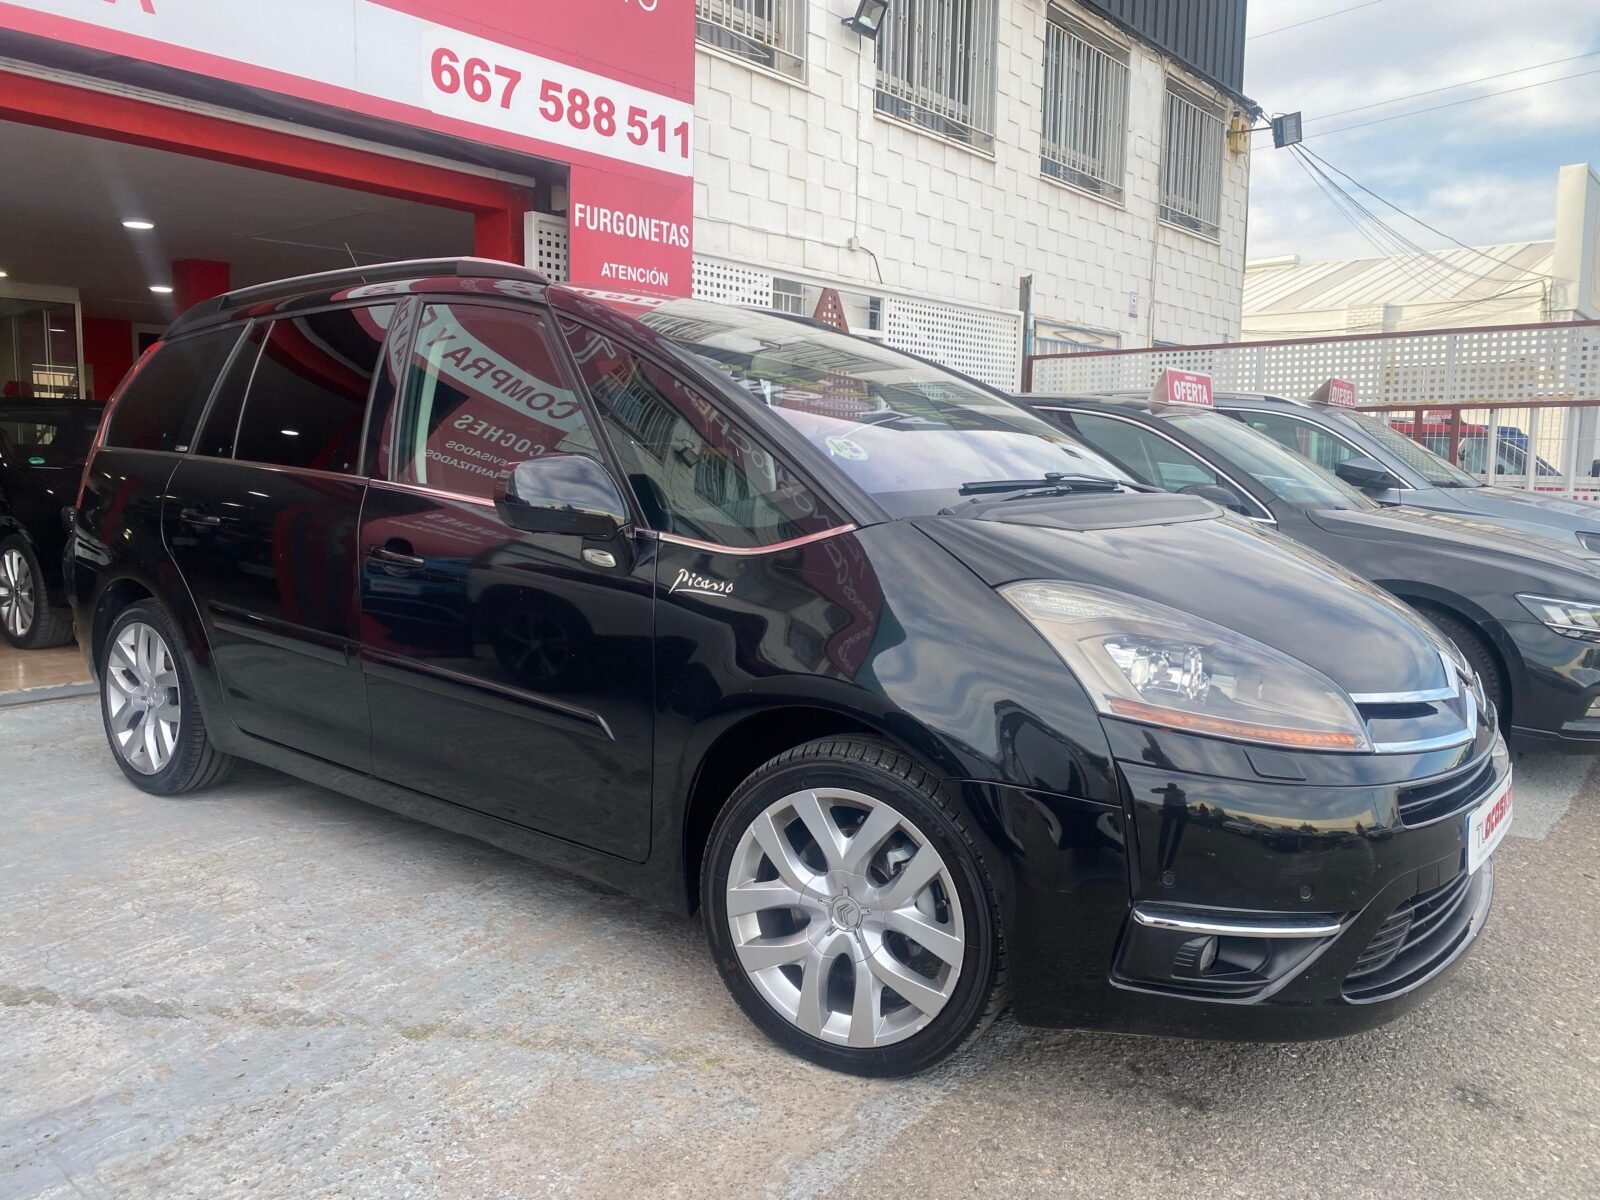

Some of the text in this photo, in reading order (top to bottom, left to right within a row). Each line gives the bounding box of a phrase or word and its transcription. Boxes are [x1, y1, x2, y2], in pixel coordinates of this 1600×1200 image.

[430, 47, 689, 159] 667 588 511
[575, 203, 689, 248] FURGONETAS
[601, 262, 668, 287] ATENCIÓN
[1173, 380, 1209, 404] OFERTA
[1331, 386, 1354, 406] DIESEL
[669, 568, 734, 597] Picasso
